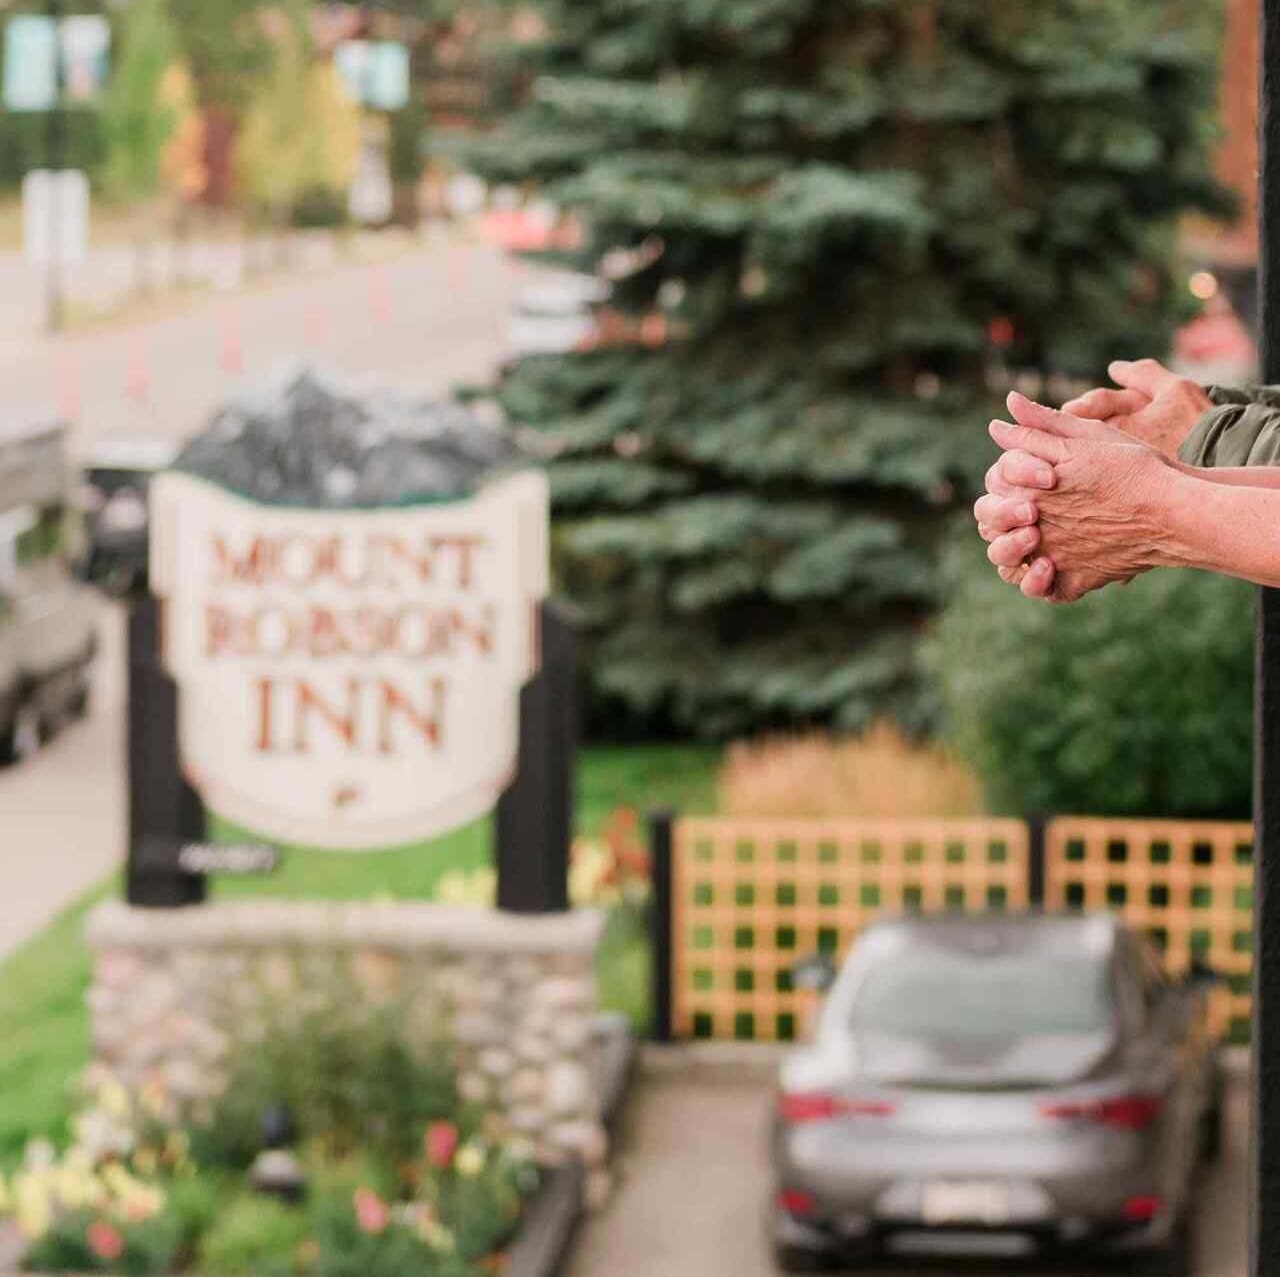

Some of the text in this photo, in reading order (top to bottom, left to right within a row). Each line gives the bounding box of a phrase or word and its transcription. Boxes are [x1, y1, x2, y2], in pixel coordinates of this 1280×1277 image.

[211, 533, 486, 589] MOUNT
[204, 605, 495, 659] ROBSON
[252, 676, 447, 754] INN
